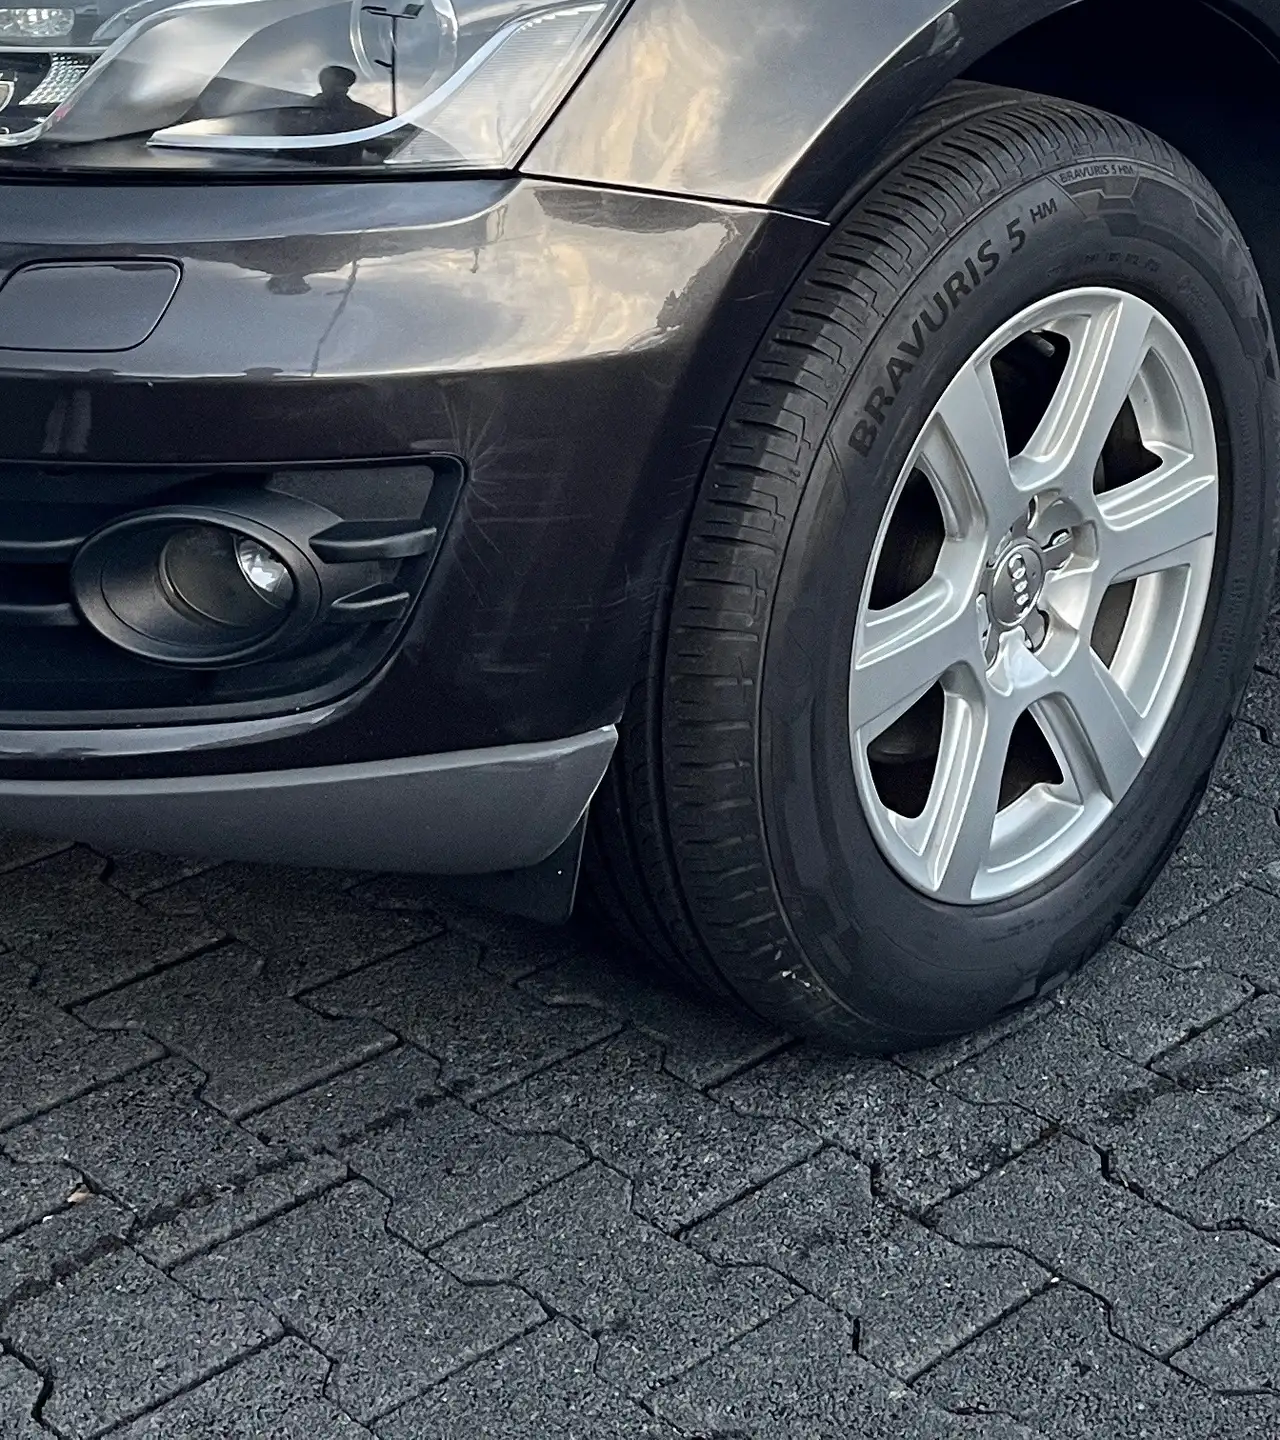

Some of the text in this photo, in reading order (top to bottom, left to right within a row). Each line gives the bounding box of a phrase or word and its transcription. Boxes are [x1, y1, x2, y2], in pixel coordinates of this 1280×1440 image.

[848, 197, 1058, 457] BRAVURIS 5 HM
